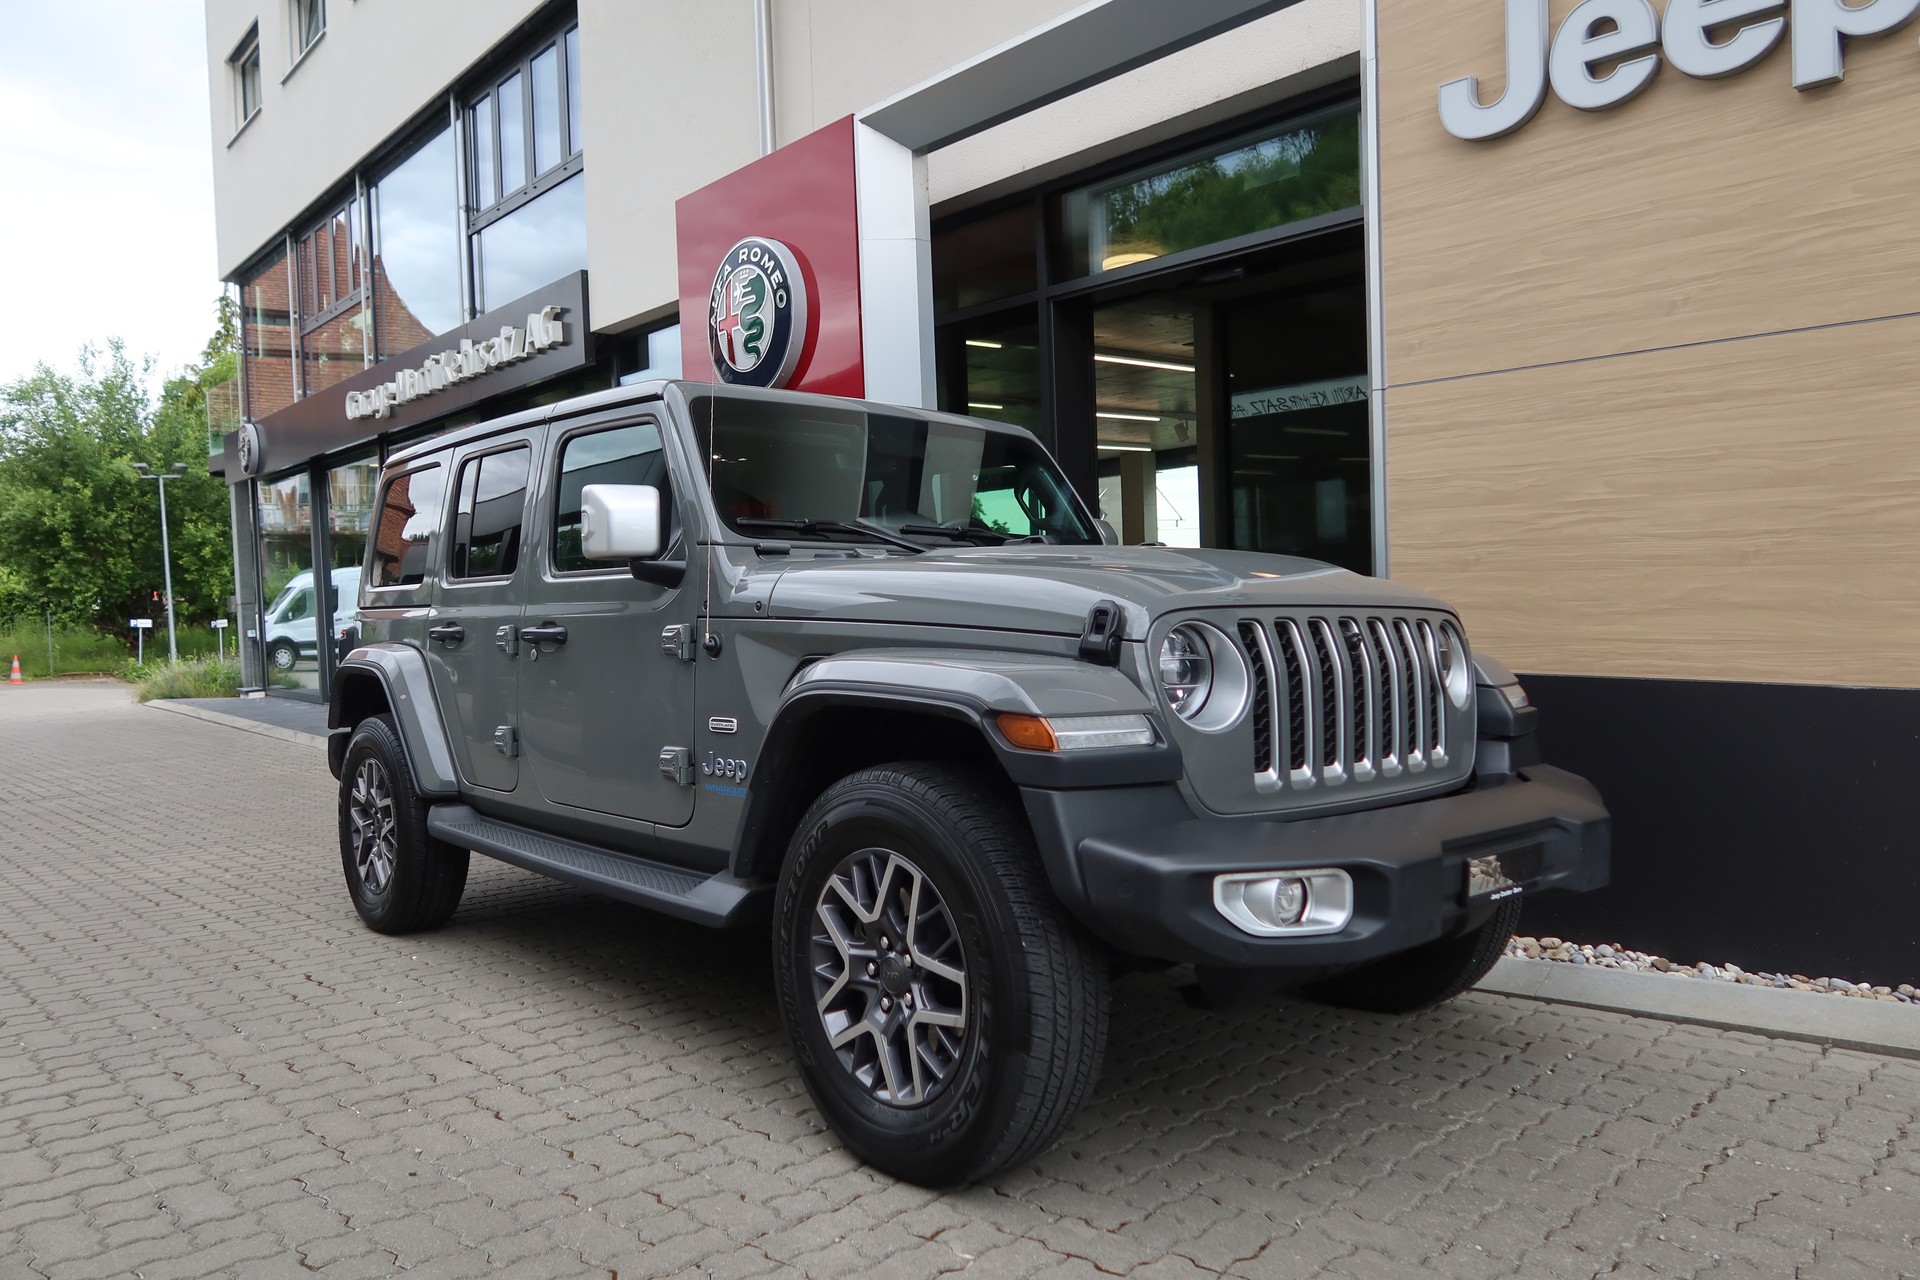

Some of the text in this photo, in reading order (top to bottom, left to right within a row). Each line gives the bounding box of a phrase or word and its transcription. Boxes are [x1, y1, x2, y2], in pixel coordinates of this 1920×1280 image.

[1438, 0, 1920, 140] Jeep
[710, 247, 787, 329] ALFA ROMEO
[523, 305, 564, 354] AG
[702, 751, 747, 783] Jeep
